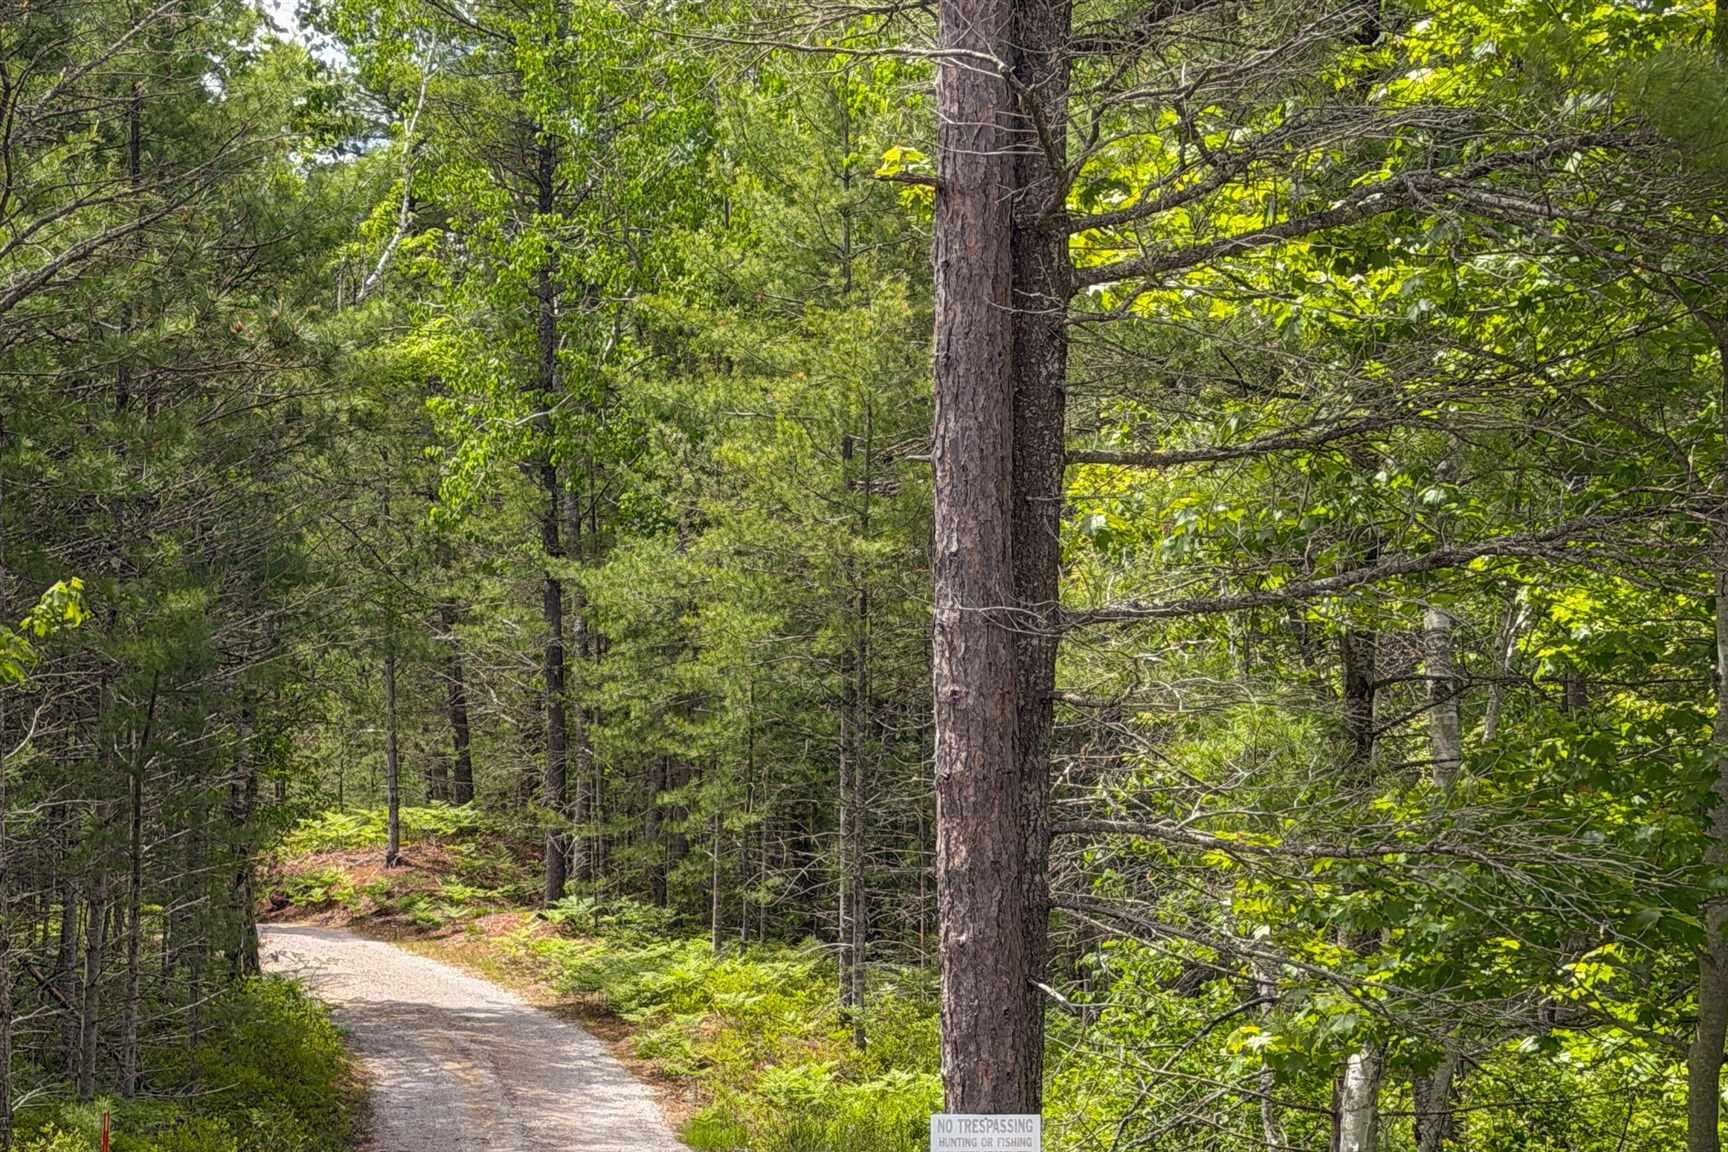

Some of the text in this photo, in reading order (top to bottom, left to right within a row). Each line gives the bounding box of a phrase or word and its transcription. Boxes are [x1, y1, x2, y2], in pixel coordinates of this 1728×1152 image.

[937, 1119, 1033, 1133] NO TRESPASSING
[938, 1137, 1033, 1147] HUNTING OR FISHING
